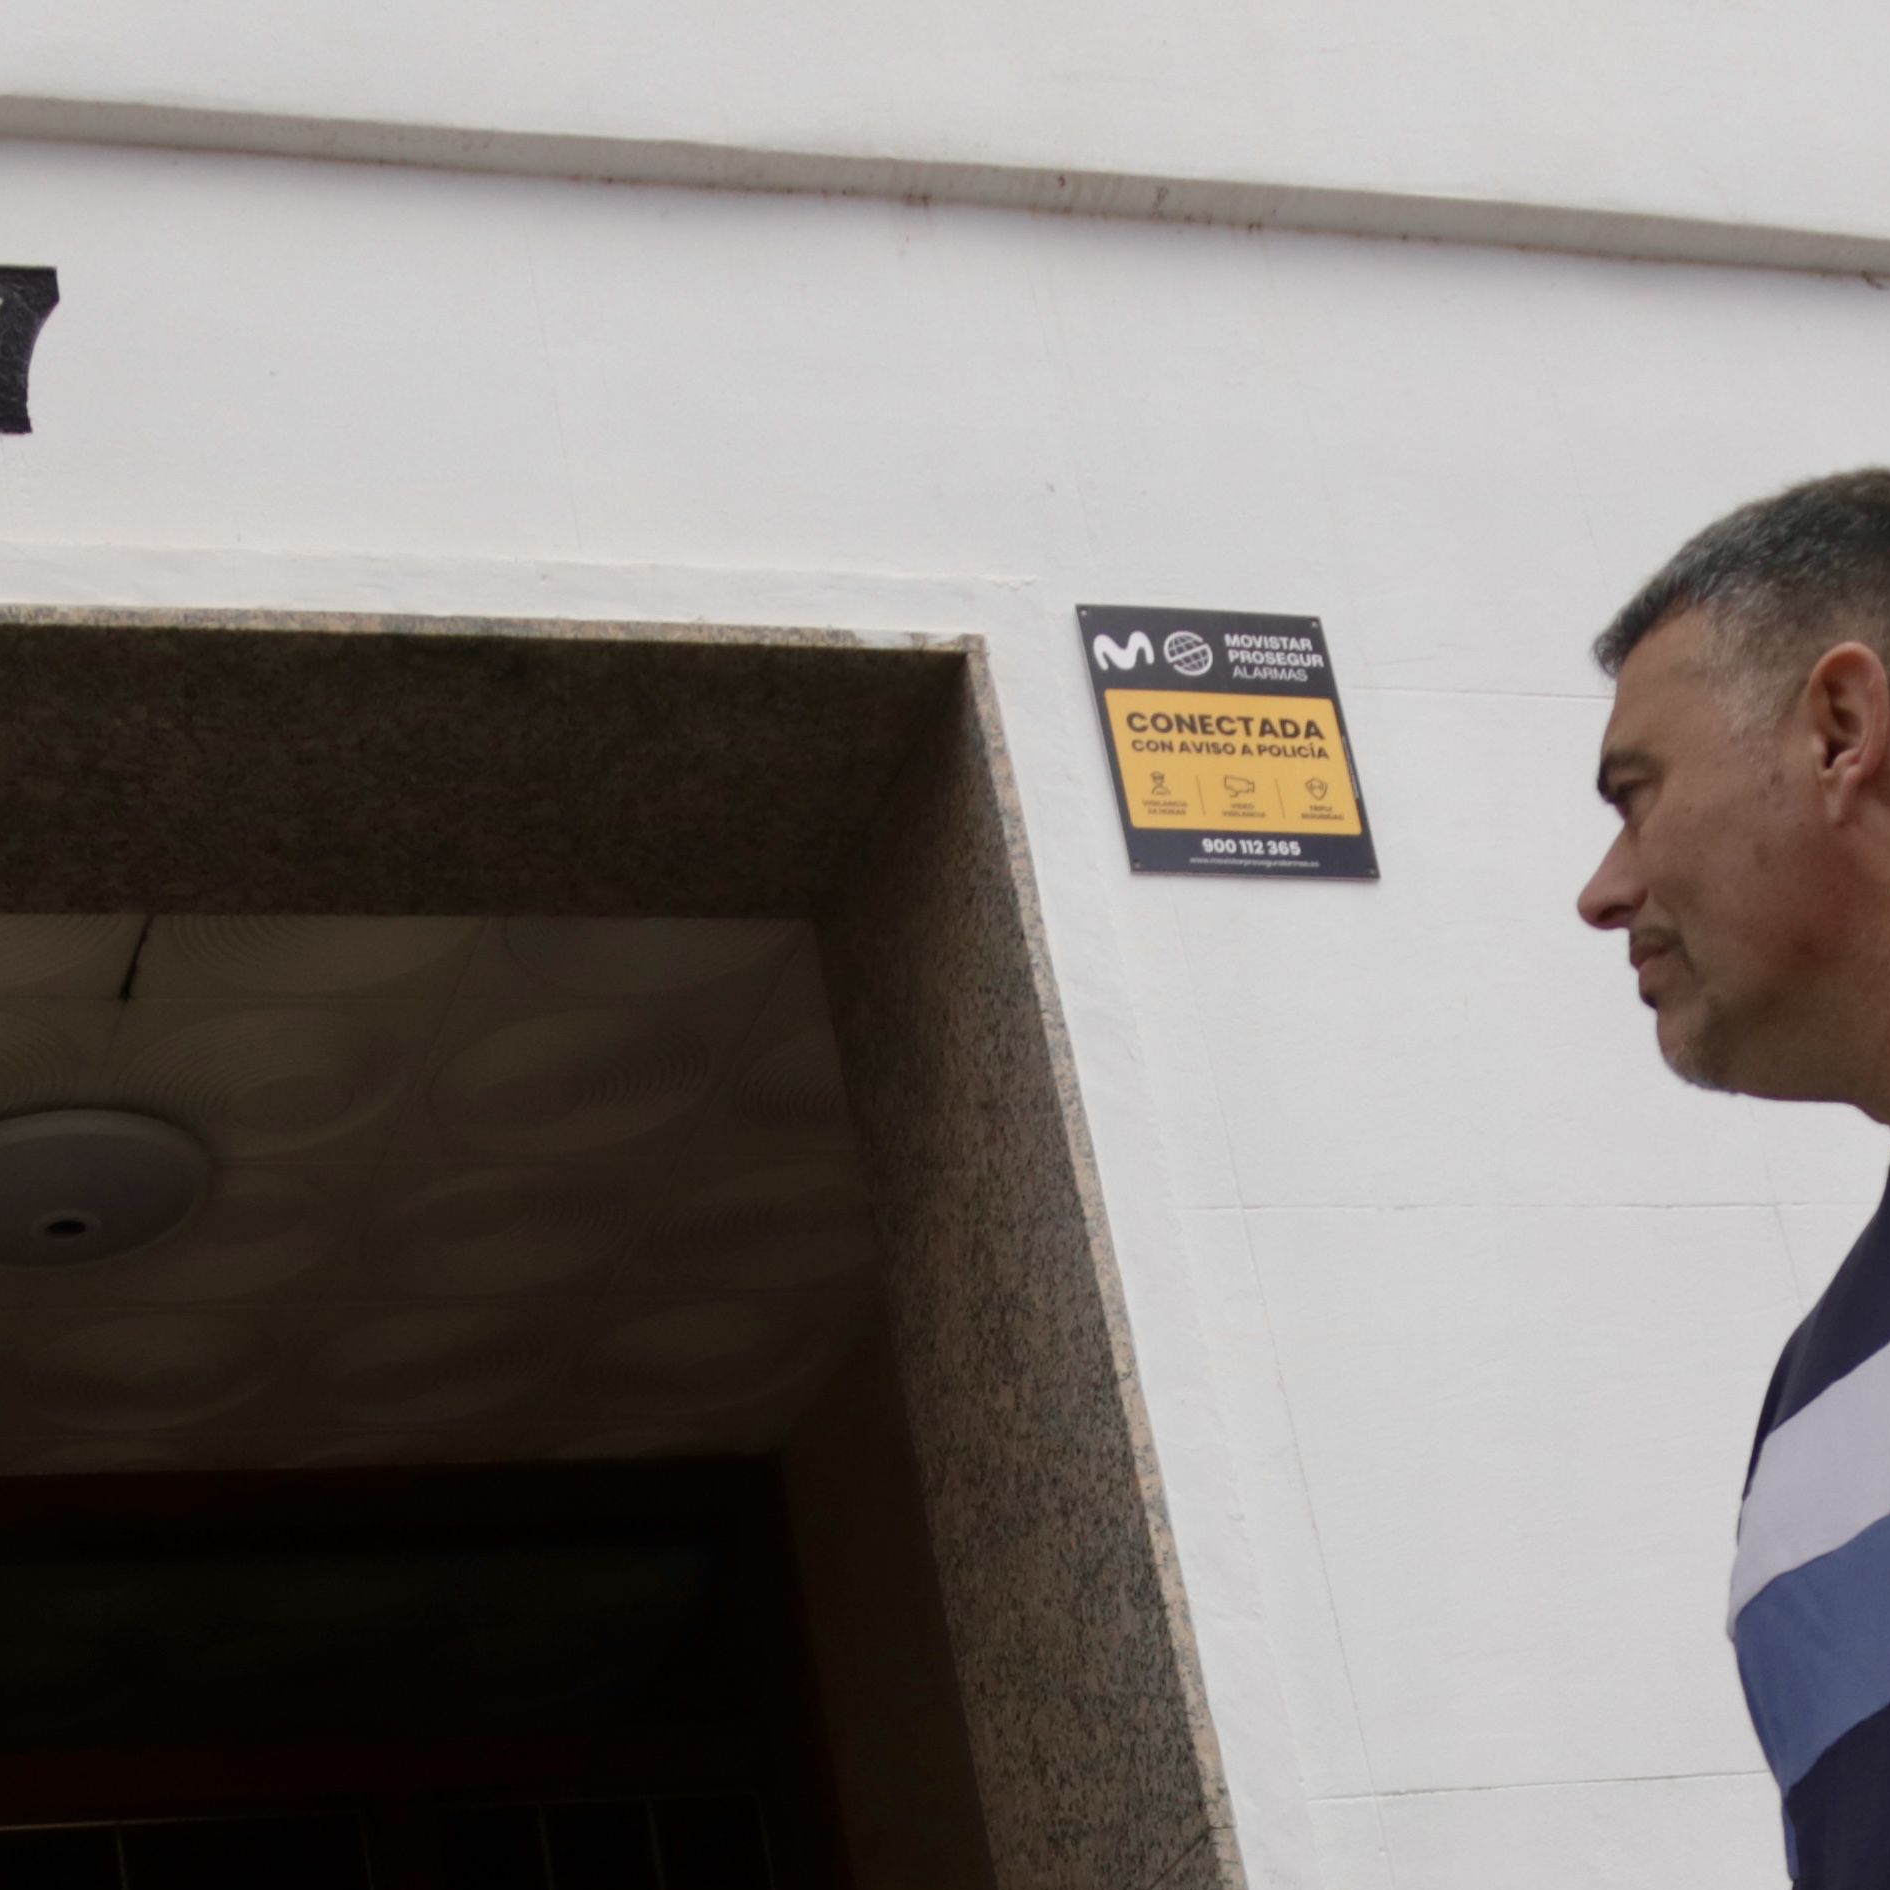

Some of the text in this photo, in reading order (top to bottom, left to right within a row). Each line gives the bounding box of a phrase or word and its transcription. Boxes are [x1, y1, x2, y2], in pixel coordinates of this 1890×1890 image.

[1224, 633, 1314, 652] MOVISTAR
[1228, 650, 1325, 668] PROSEGUR
[1232, 666, 1309, 682] ALARMAS
[1126, 711, 1326, 741] CONECTADA
[1131, 739, 1330, 760] CON AVISO A POLICÍA
[1201, 837, 1302, 857] 900 112 365
